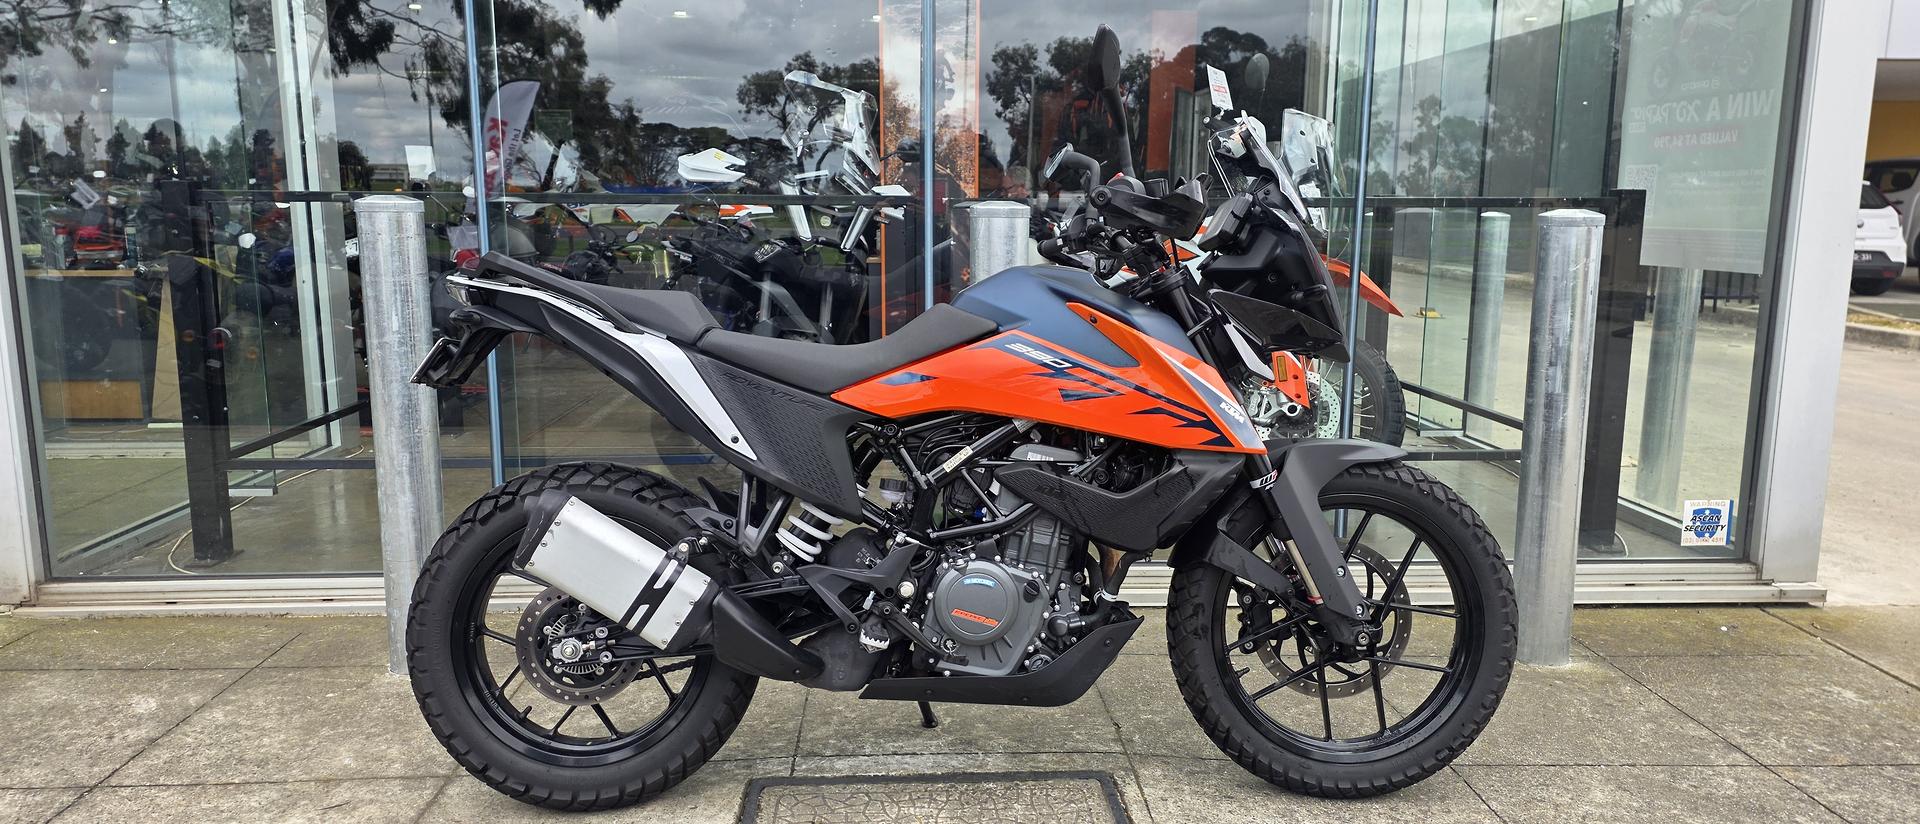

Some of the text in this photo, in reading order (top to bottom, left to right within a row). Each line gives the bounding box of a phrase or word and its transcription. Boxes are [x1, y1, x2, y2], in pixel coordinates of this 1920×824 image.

[1004, 342, 1073, 368] 390
[1219, 401, 1245, 424] KTM
[1683, 524, 1726, 532] SECURITY
